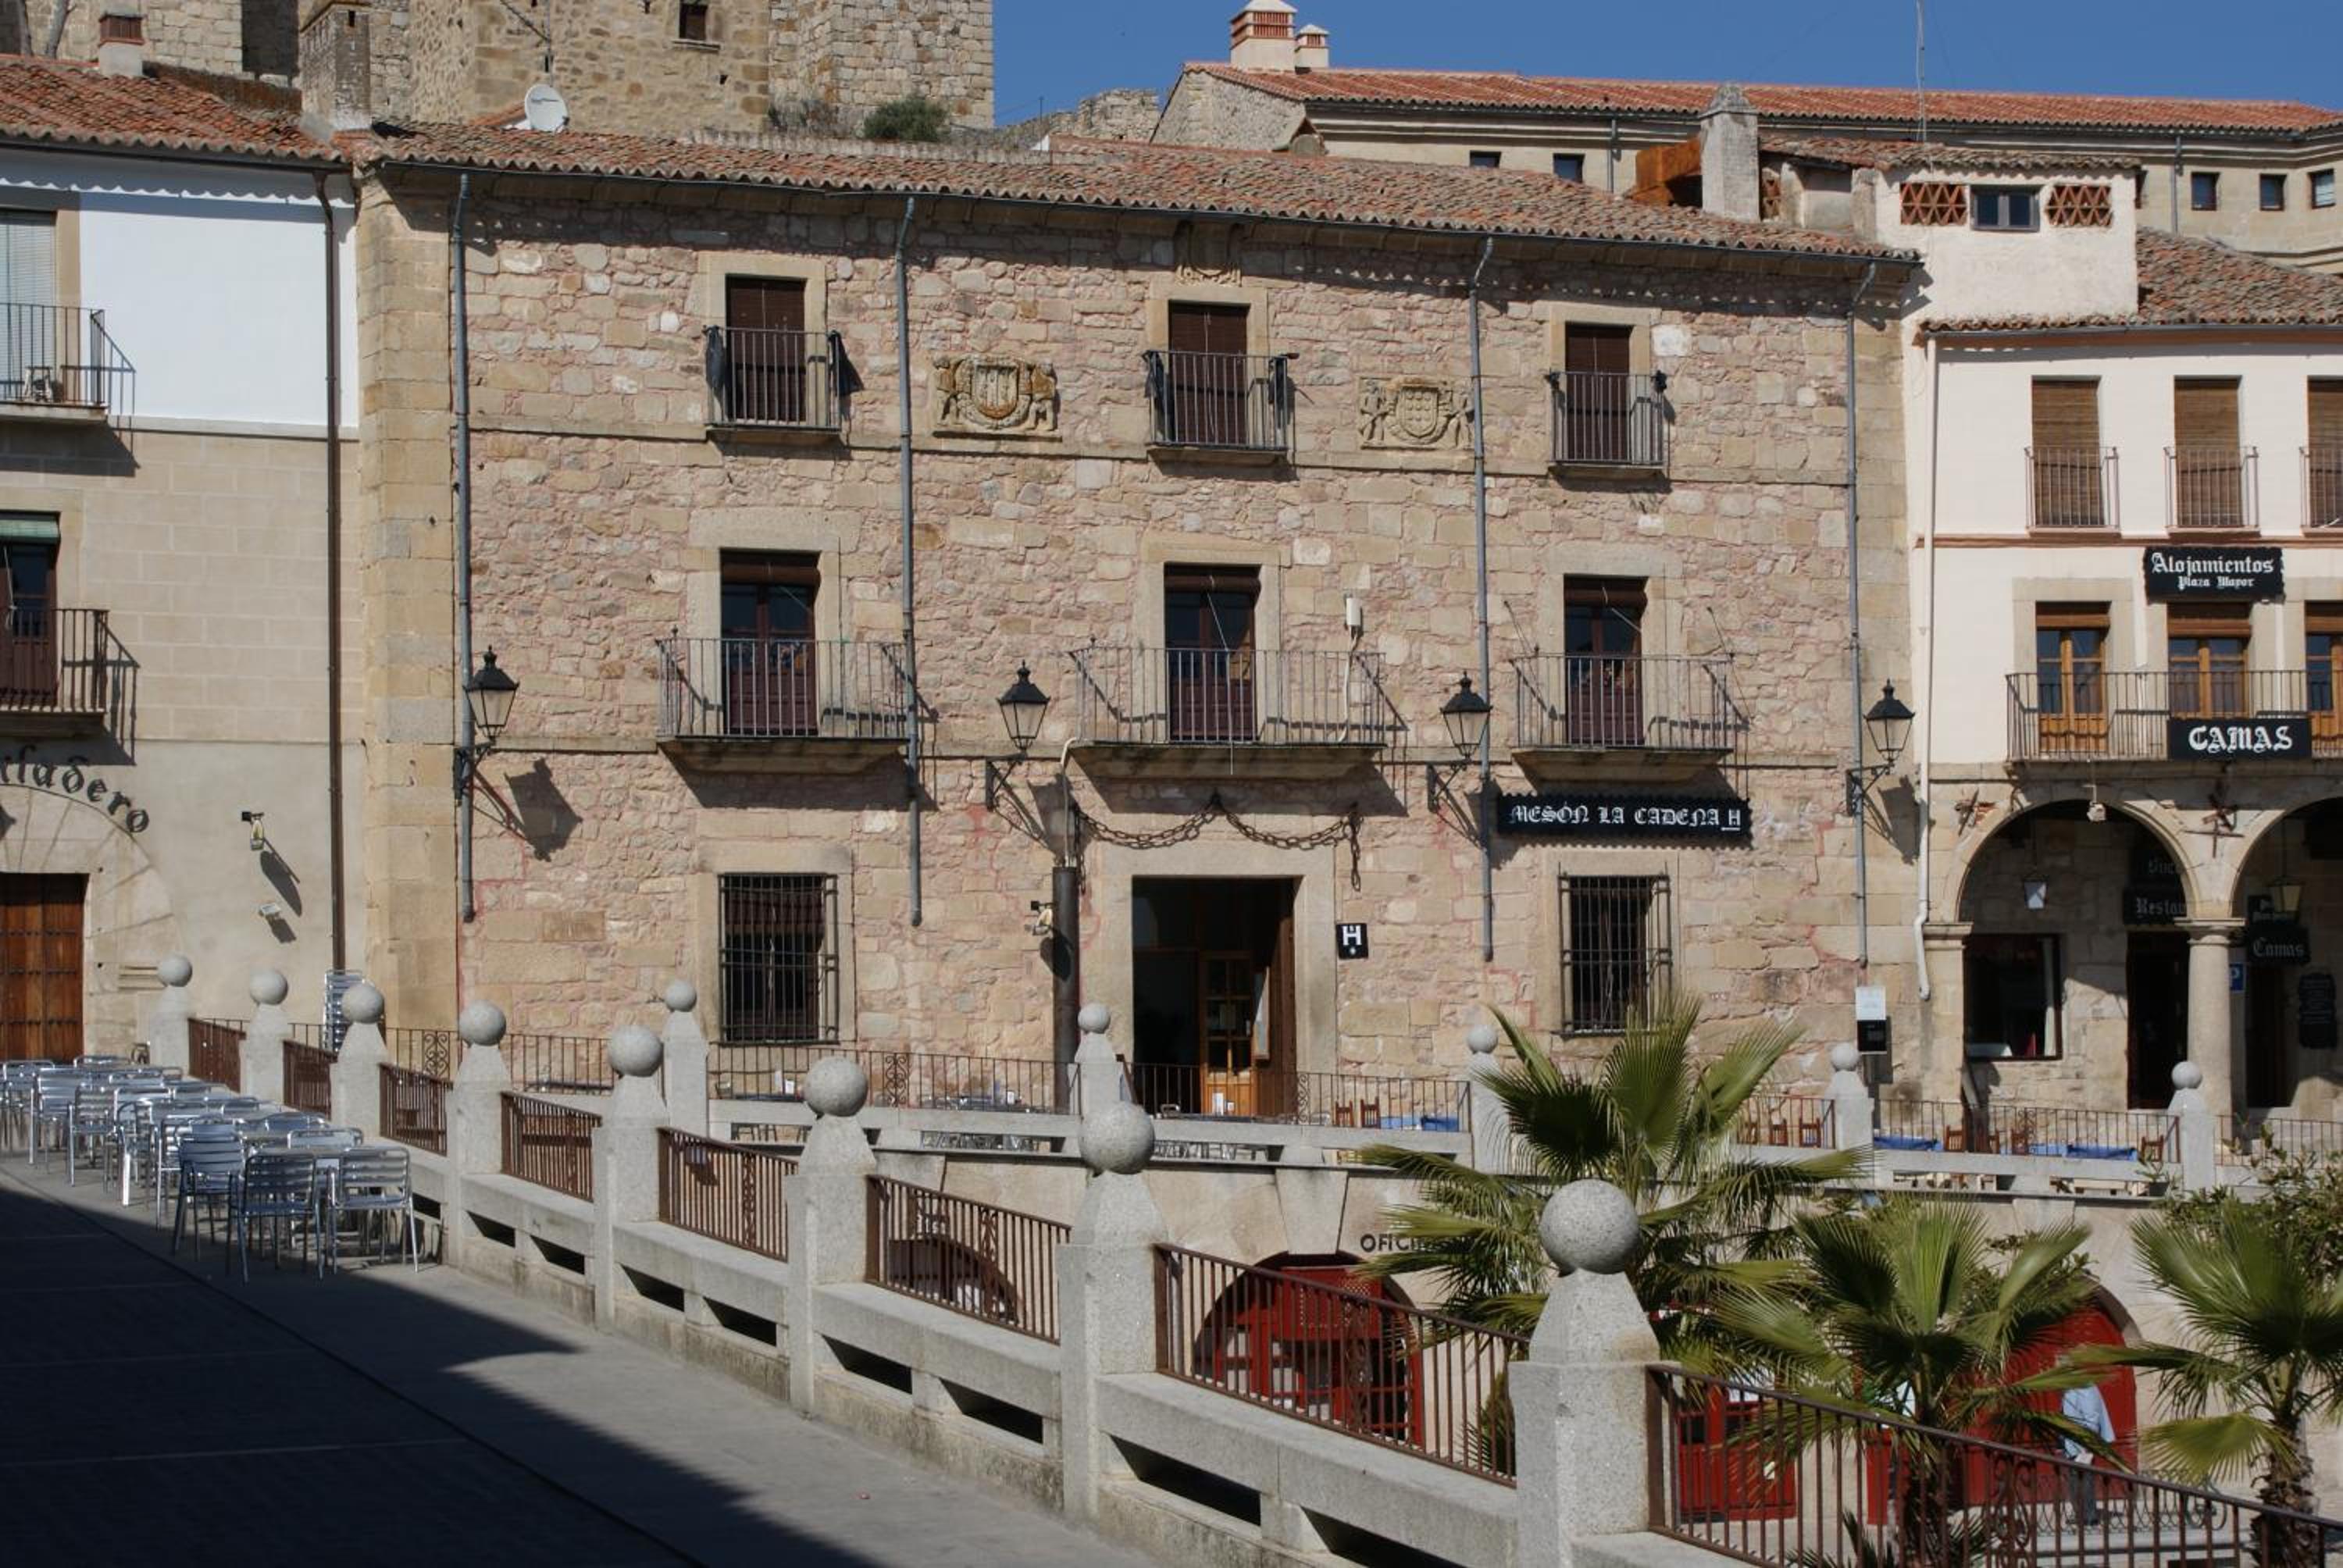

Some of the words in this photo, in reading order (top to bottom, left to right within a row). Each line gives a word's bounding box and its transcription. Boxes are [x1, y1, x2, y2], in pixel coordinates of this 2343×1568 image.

[2152, 551, 2274, 576] Alojamientos
[2177, 576, 2210, 591] Plaza
[2216, 576, 2255, 590] Mayor
[2188, 725, 2293, 754] CAMAS
[1597, 806, 1625, 825] LA
[1634, 807, 1720, 827] CADENA
